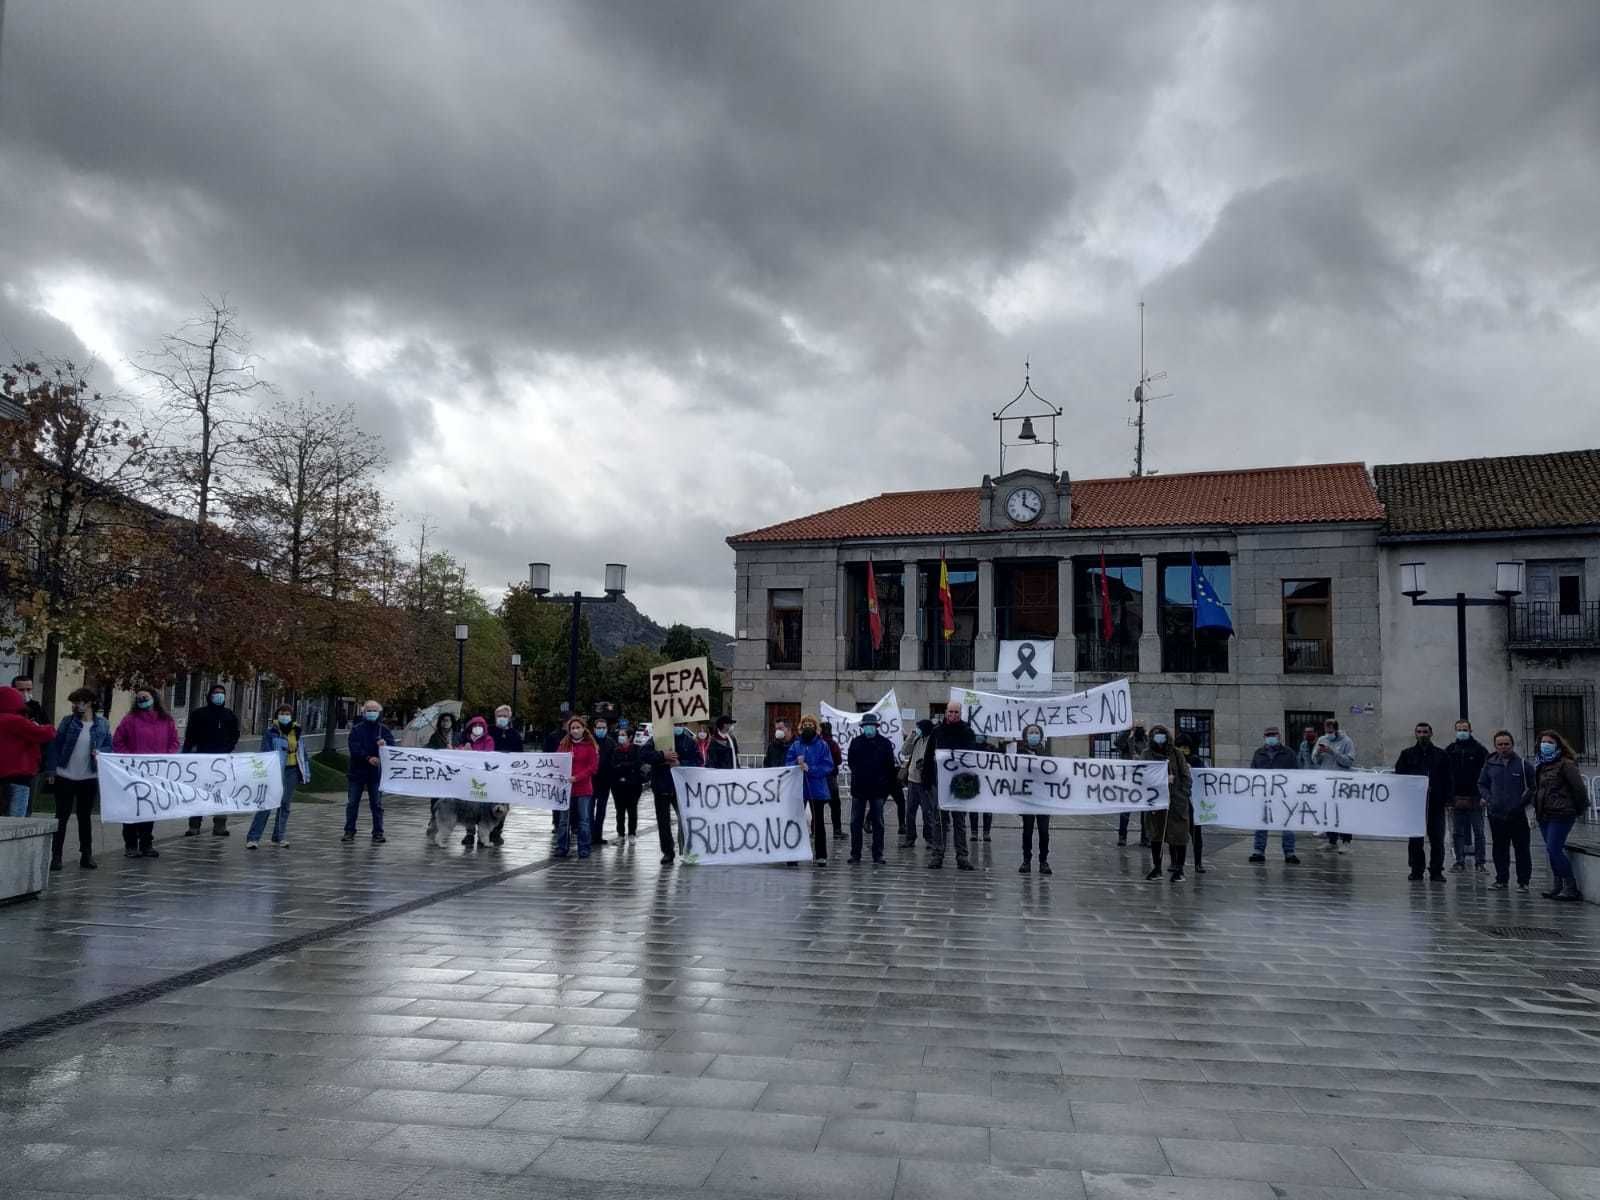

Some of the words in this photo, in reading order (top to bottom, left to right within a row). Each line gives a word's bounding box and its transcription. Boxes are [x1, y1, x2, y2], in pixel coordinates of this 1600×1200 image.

[967, 704, 1093, 734] KAMIKAZES
[1100, 689, 1127, 725] NO
[943, 752, 1059, 775] ¿CUANTO
[1073, 761, 1148, 785] MONTE
[986, 776, 1034, 797] VALE
[1045, 778, 1072, 800] TÚ
[1087, 783, 1160, 806] MOTO?
[1197, 772, 1289, 798] RADAR
[1297, 782, 1318, 795] DE
[1325, 776, 1390, 803] TRAMO
